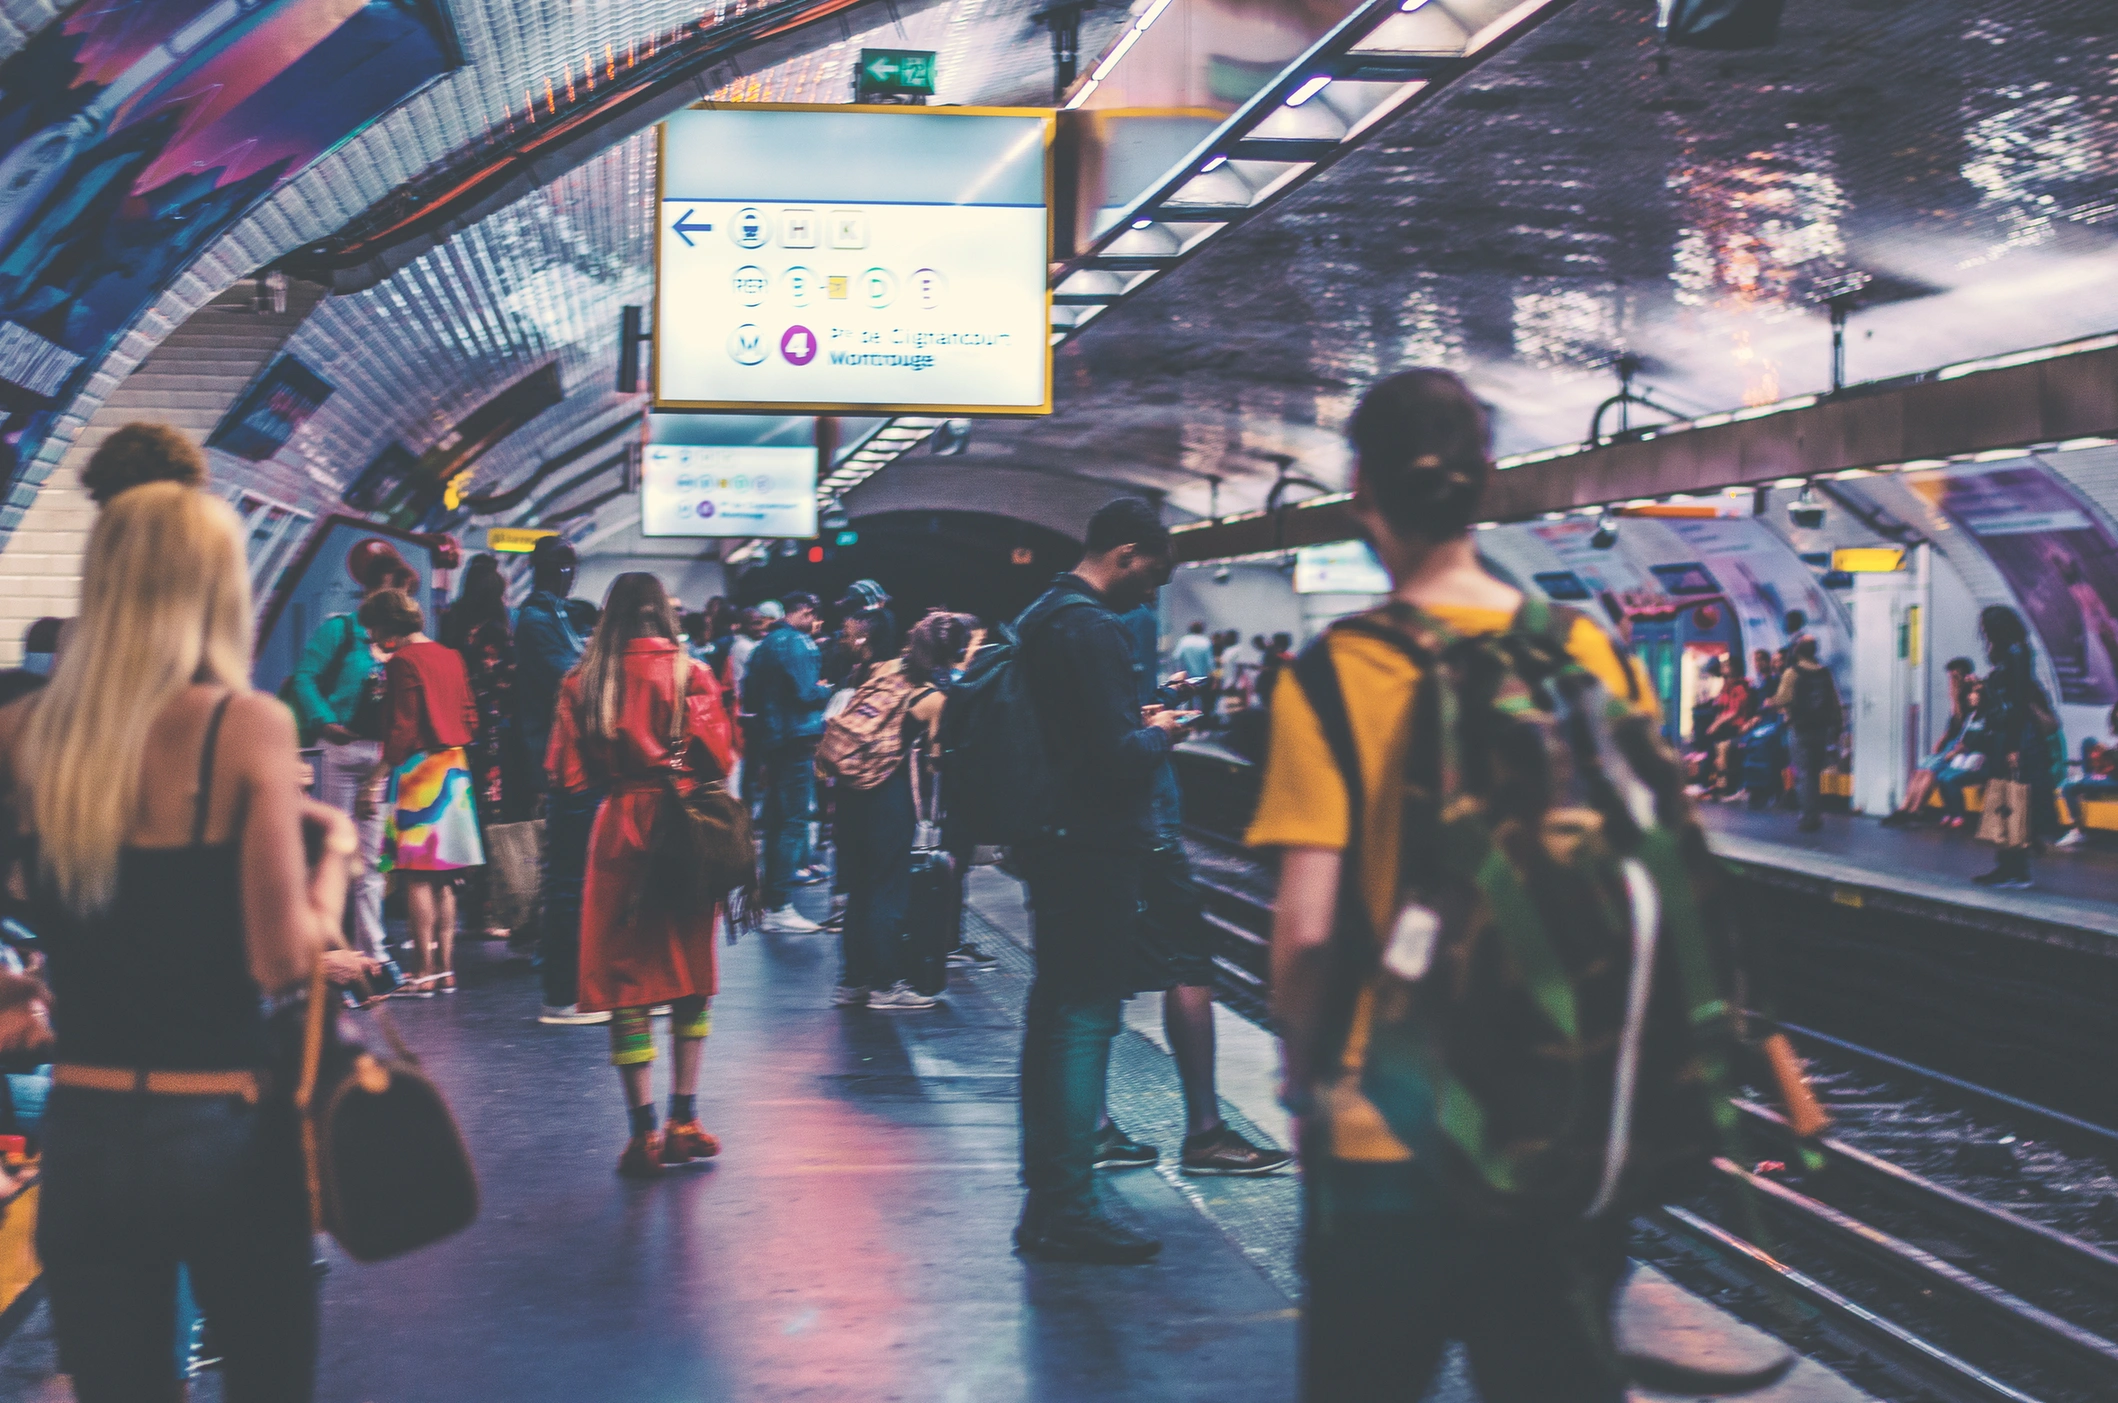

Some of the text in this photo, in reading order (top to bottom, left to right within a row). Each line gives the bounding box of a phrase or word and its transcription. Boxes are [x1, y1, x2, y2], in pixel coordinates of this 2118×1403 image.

[788, 219, 858, 240] H K
[868, 278, 888, 299] D
[785, 332, 810, 358] 4
